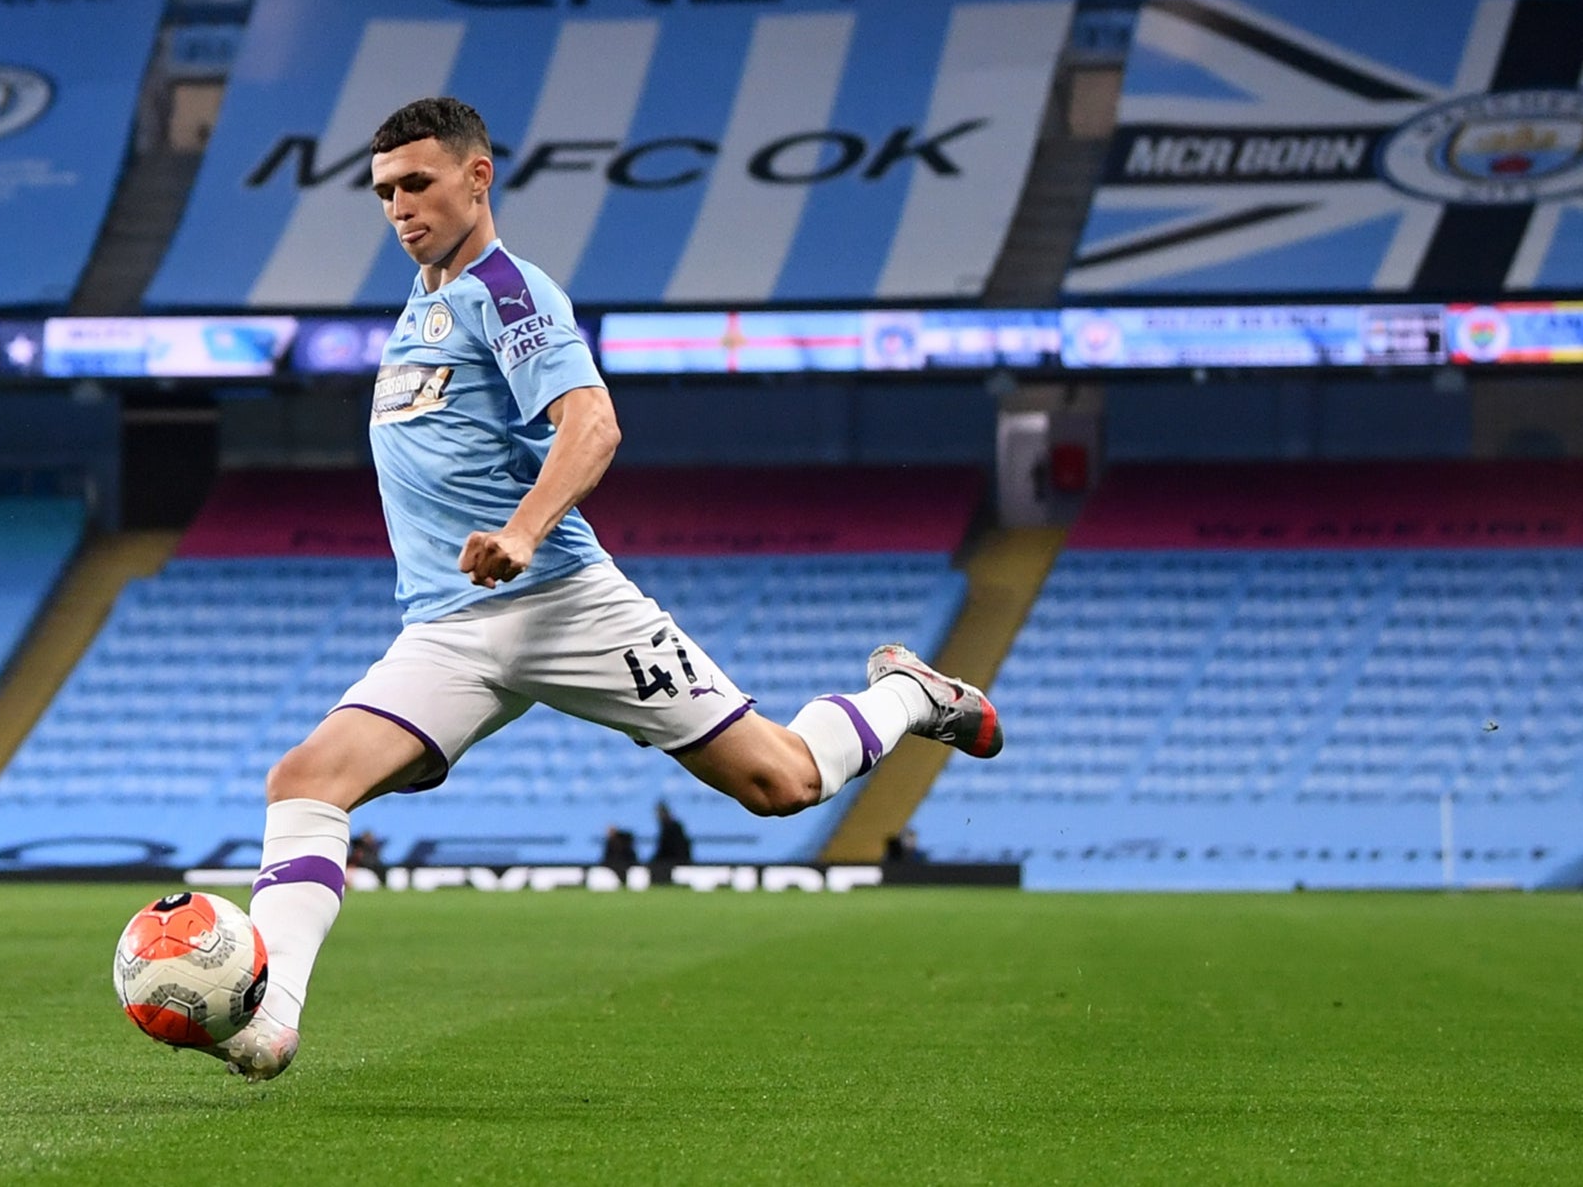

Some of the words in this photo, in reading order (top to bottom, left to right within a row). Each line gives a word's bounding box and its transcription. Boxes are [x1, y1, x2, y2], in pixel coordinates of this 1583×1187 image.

[245, 133, 722, 190] MFC
[747, 118, 989, 185] OK
[1126, 134, 1235, 175] MCR
[1235, 132, 1365, 173] BORN
[623, 626, 698, 702] 47
